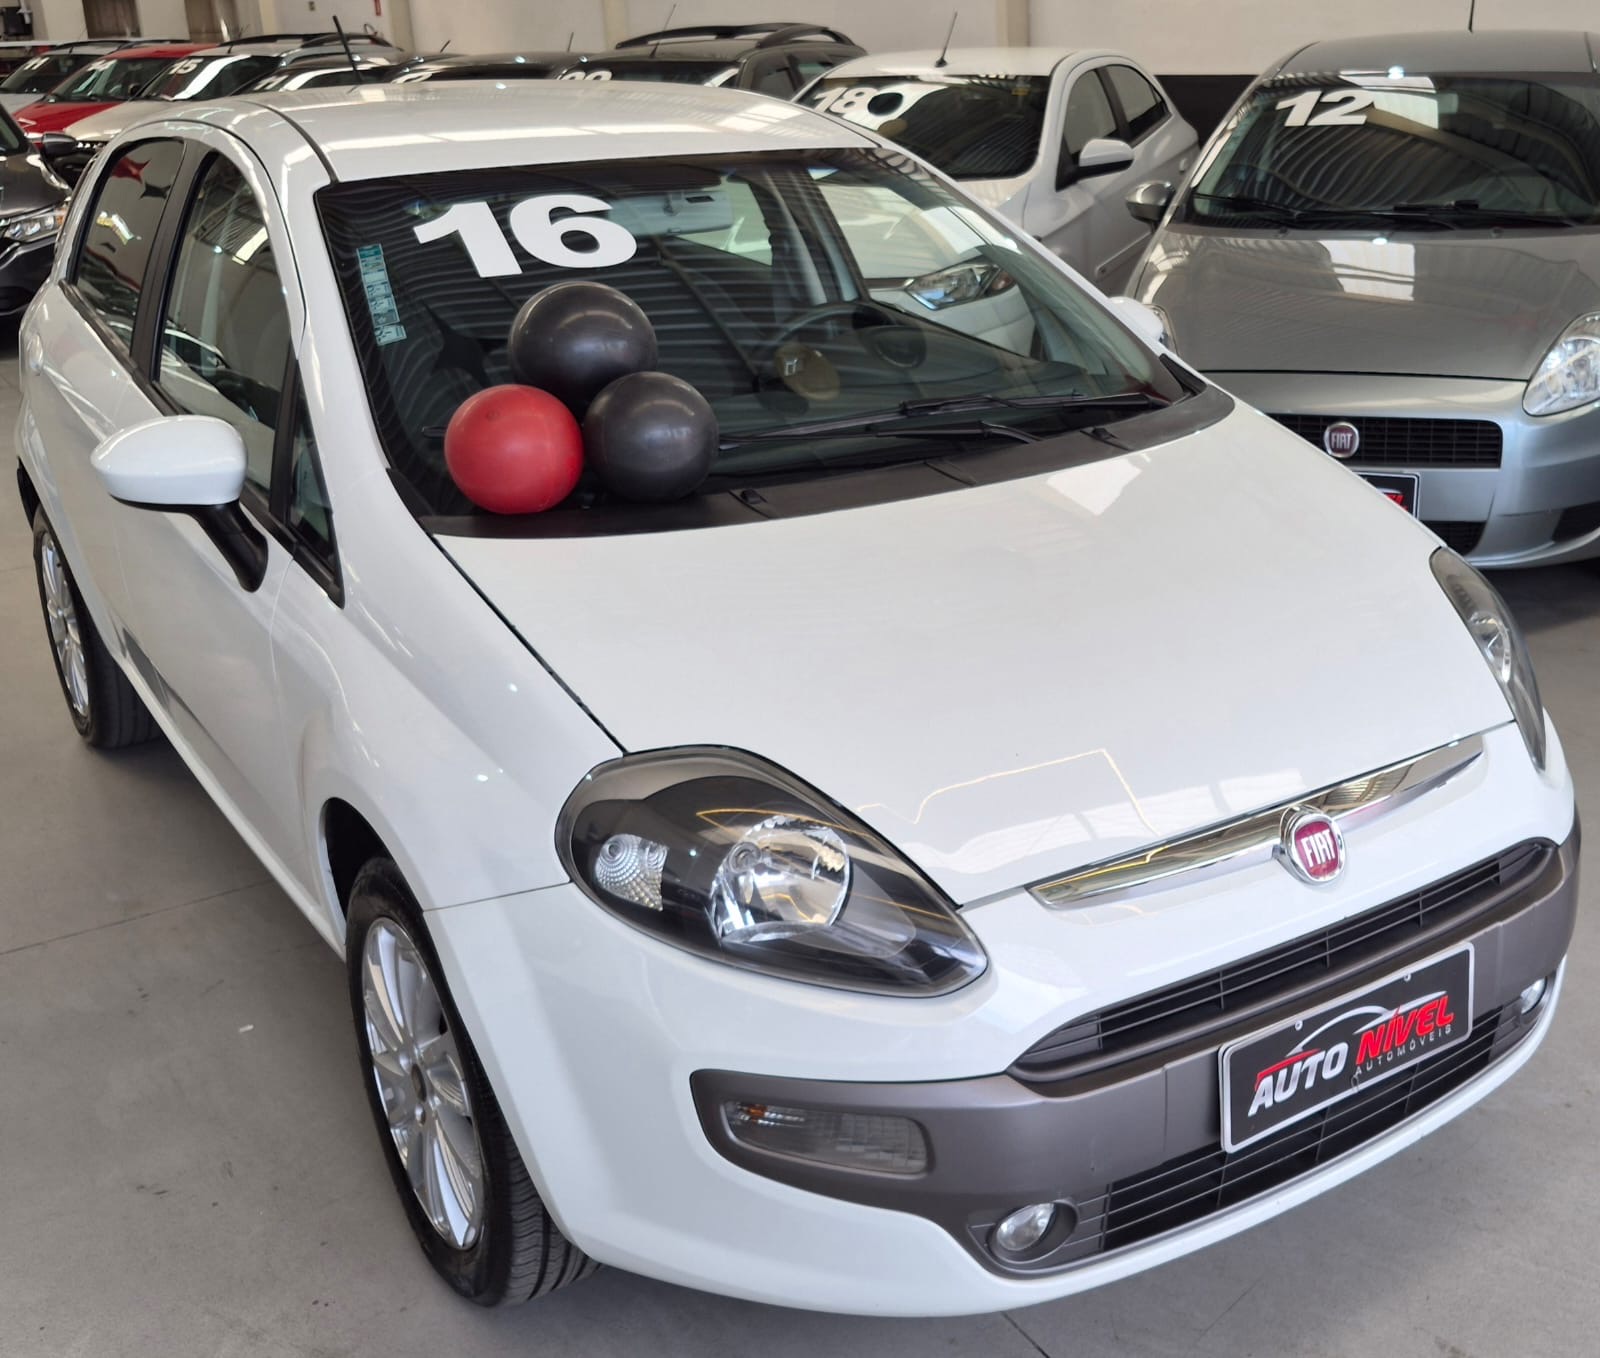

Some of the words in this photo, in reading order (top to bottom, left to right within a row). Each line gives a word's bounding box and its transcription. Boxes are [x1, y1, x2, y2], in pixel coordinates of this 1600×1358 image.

[812, 87, 878, 115] 18
[1275, 89, 1376, 127] 12
[412, 194, 638, 278] 16
[1331, 432, 1353, 449] FIAT
[1300, 828, 1336, 868] FIAT
[1247, 1041, 1350, 1118] AUTO
[1355, 994, 1455, 1066] NÍVEL
[1354, 1024, 1453, 1077] AUTOMÓVEIS
